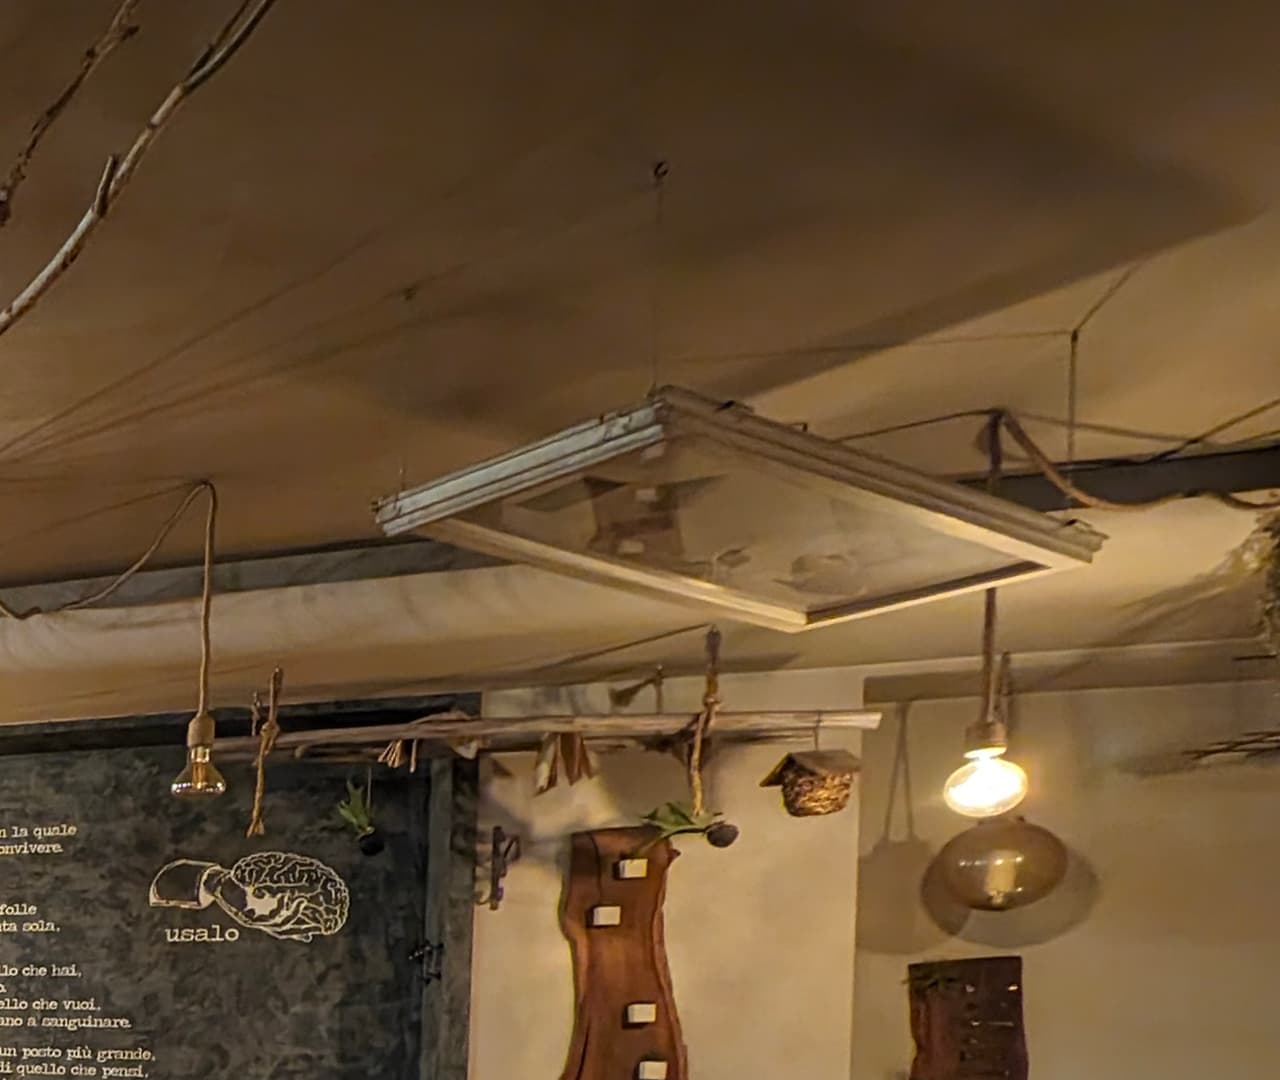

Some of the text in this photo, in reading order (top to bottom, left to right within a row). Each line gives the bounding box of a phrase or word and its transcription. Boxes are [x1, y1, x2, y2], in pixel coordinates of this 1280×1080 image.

[12, 826, 28, 837] la
[33, 824, 77, 839] quale
[165, 924, 239, 943] usalo
[22, 965, 47, 976] che
[32, 998, 57, 1010] che
[27, 1017, 37, 1026] a
[0, 1047, 16, 1056] un
[22, 1047, 61, 1059] posto
[67, 1046, 91, 1060] più
[16, 1063, 66, 1076] quello
[71, 1064, 96, 1076] che
